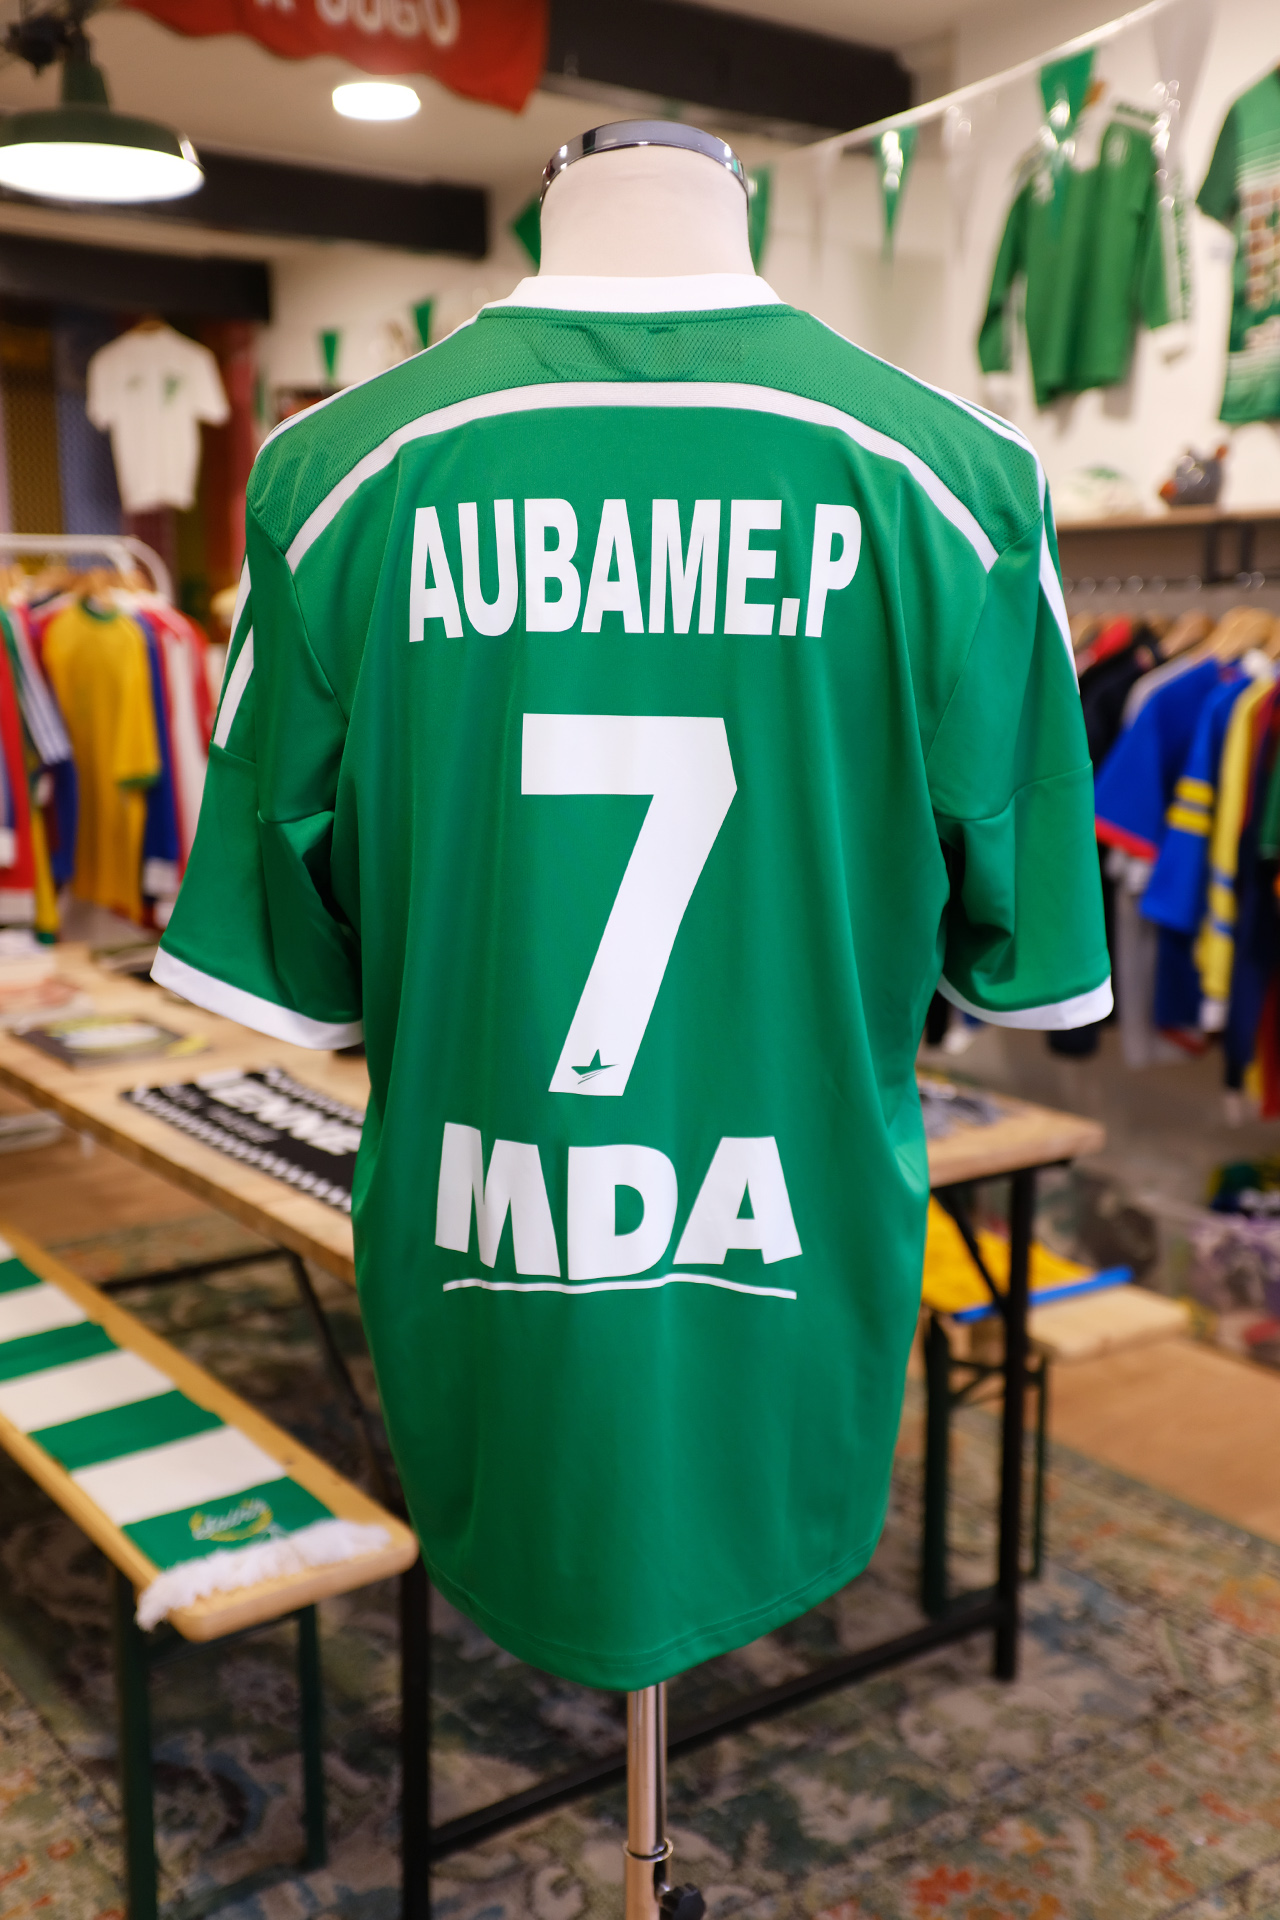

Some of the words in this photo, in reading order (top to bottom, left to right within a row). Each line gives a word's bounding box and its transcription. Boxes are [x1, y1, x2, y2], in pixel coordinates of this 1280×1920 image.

[409, 498, 863, 643] AUBAME.P
[520, 712, 738, 1097] 7
[435, 1122, 803, 1281] MDA
